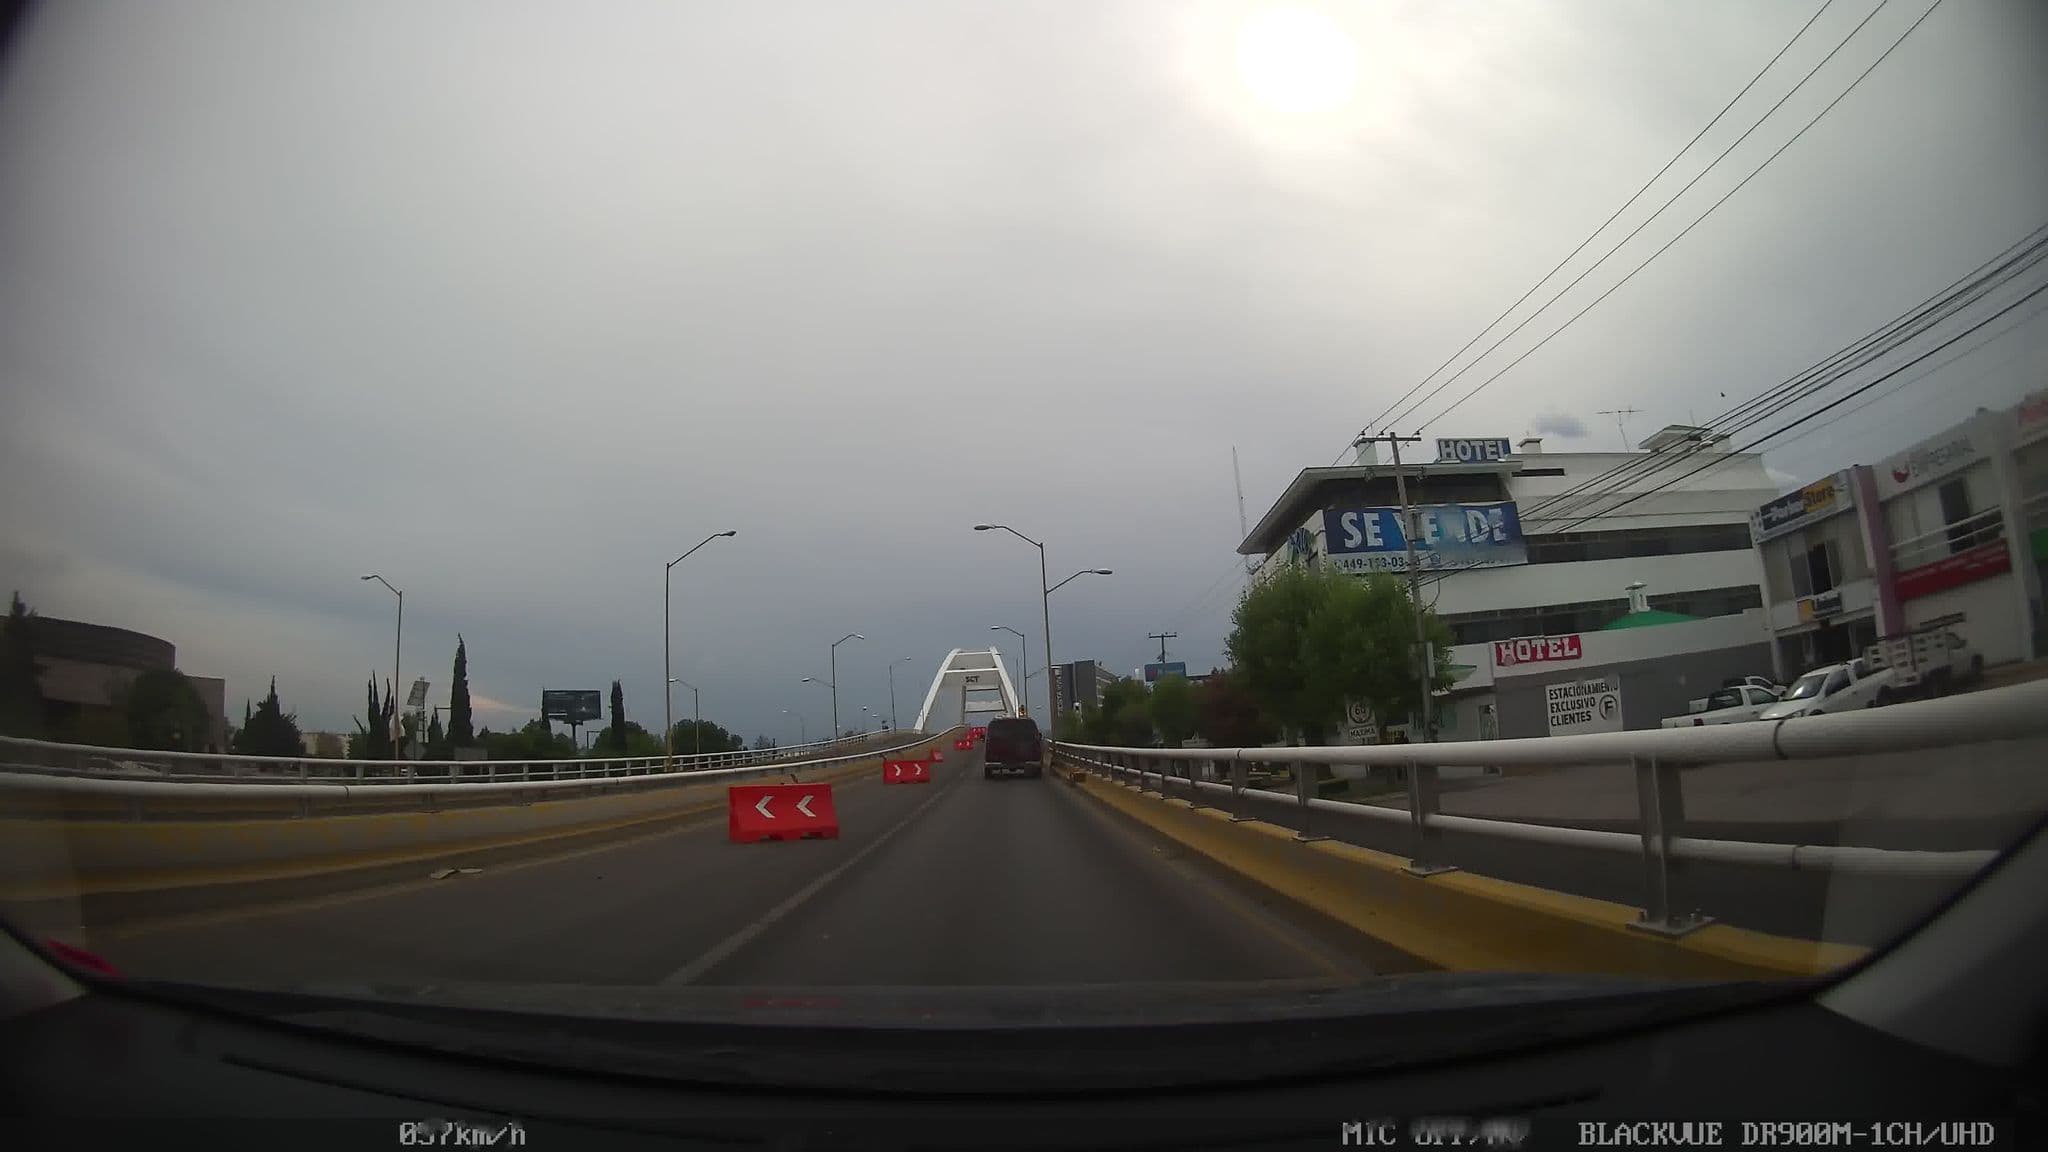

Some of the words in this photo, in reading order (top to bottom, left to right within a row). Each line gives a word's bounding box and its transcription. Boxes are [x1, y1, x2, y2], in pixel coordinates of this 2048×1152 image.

[1439, 438, 1508, 462] HOTEL
[1340, 509, 1384, 549] SE
[1499, 637, 1578, 663] HOTEL
[1550, 696, 1596, 714] EXCLUSIVO
[1550, 710, 1592, 727] CLIENTES
